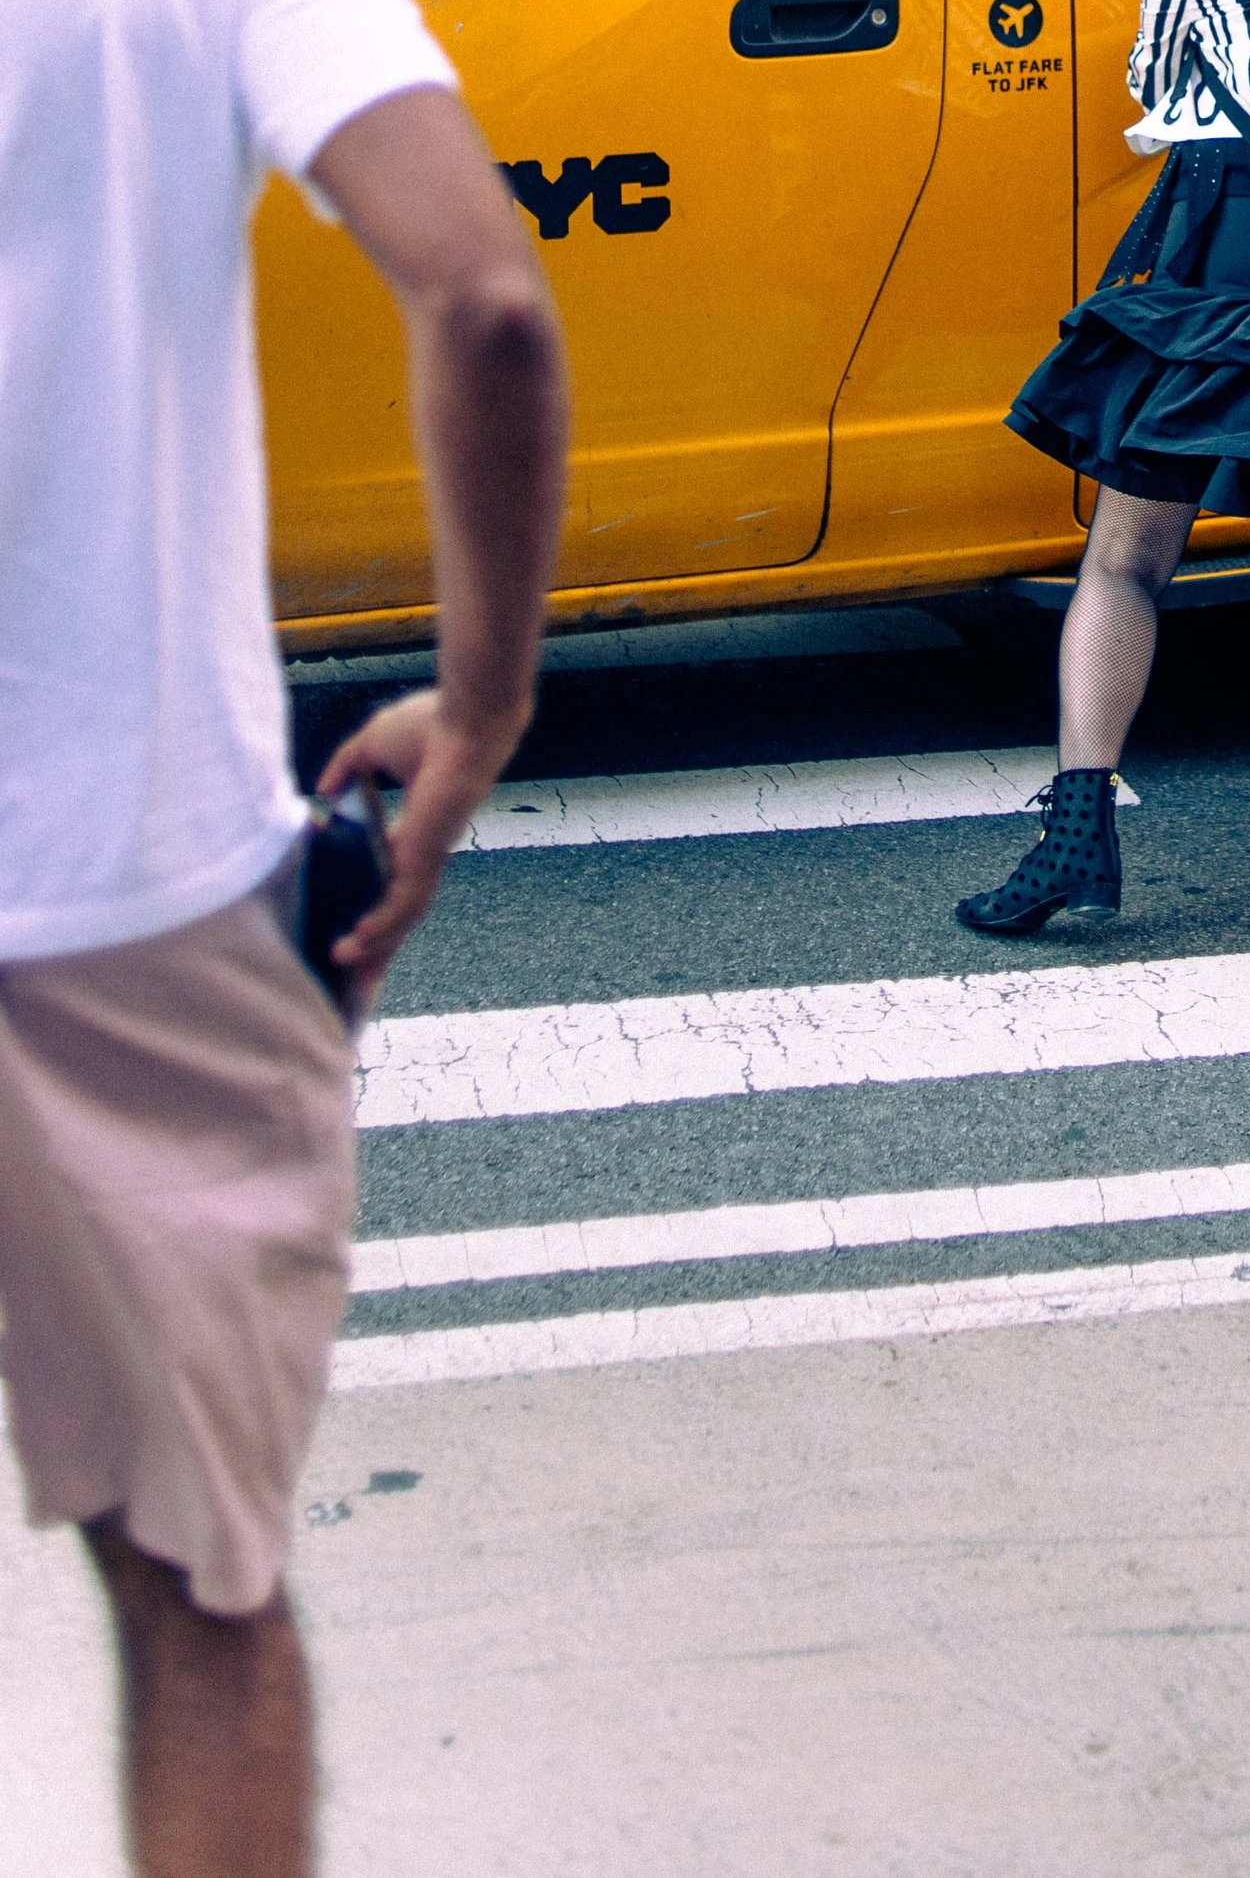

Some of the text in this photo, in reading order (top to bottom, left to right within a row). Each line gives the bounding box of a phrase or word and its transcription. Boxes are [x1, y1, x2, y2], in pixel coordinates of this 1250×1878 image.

[971, 58, 1063, 75] FLAT FARE
[988, 77, 1049, 92] TO JFK
[493, 152, 671, 240] YC
